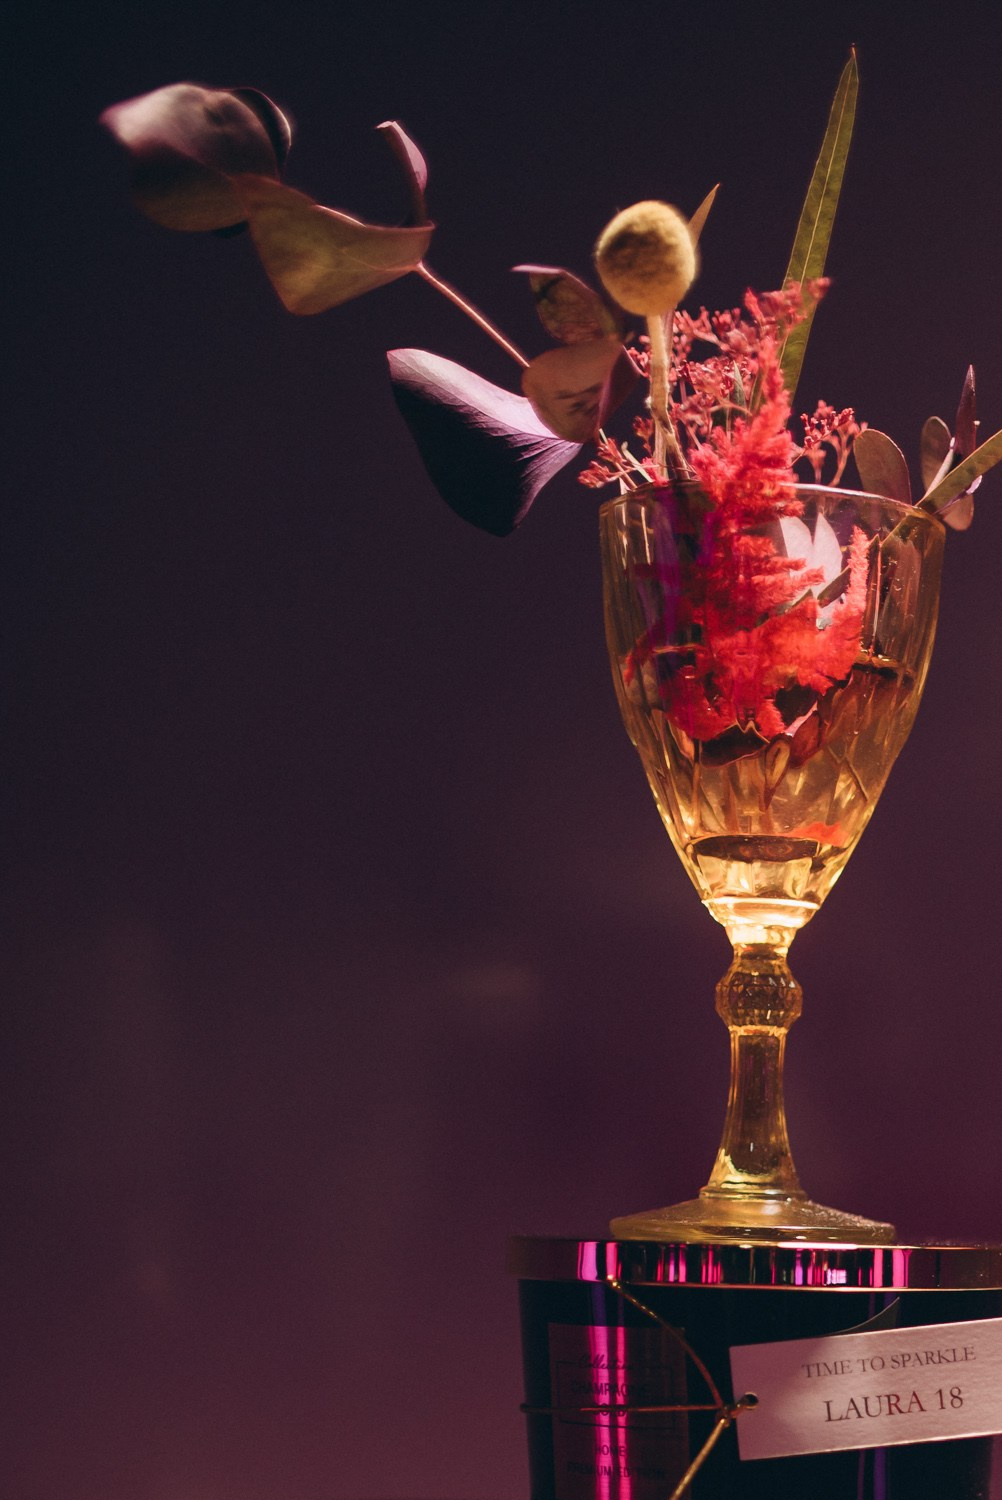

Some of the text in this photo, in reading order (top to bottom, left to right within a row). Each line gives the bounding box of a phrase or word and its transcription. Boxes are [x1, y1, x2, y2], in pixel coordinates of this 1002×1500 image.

[801, 1345, 977, 1379] TIME TO SPARKLE
[823, 1386, 964, 1422] LAURA 18
